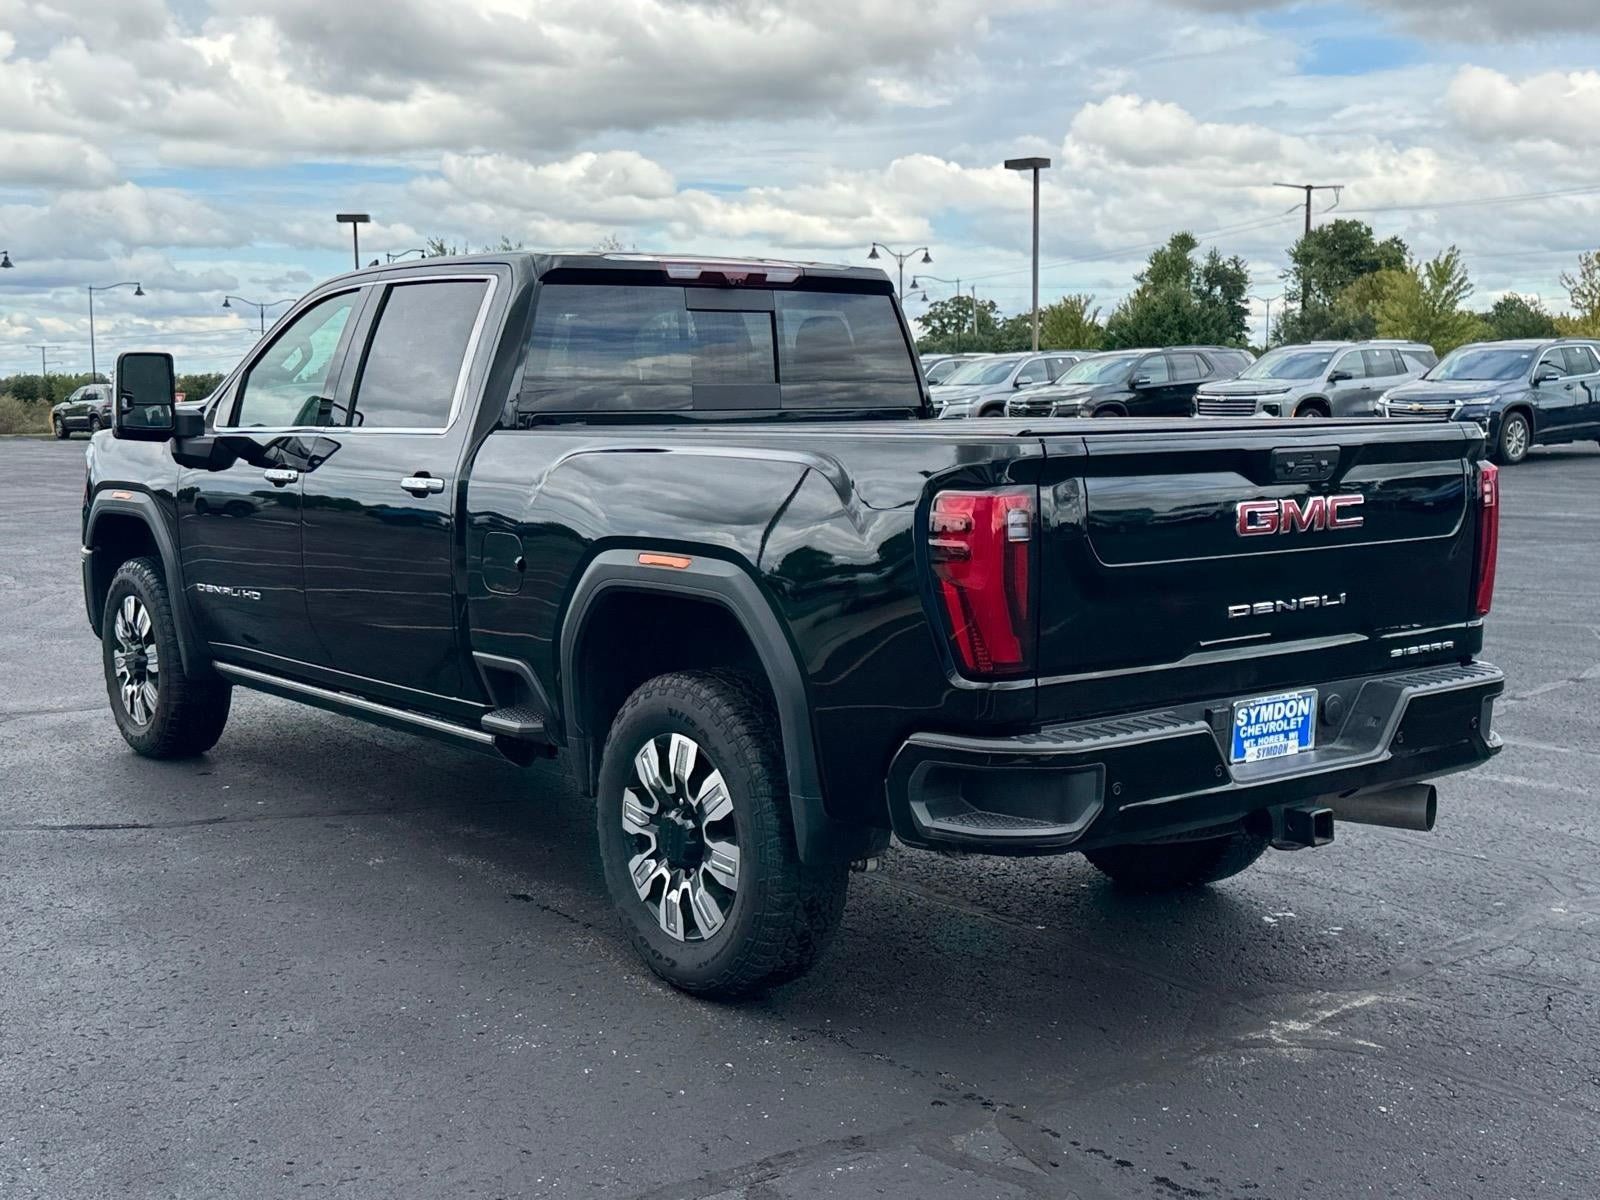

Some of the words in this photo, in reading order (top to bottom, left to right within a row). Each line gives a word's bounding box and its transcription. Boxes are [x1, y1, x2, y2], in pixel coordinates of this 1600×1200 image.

[1236, 494, 1364, 537] GMC
[197, 583, 241, 597] DENALI
[242, 589, 261, 600] HD
[1228, 592, 1346, 618] DENALI
[1390, 640, 1454, 658] SIERRA
[1237, 699, 1310, 726] SYMDON
[1240, 717, 1304, 738] CHEVROLET
[1256, 743, 1288, 759] SYMDON
